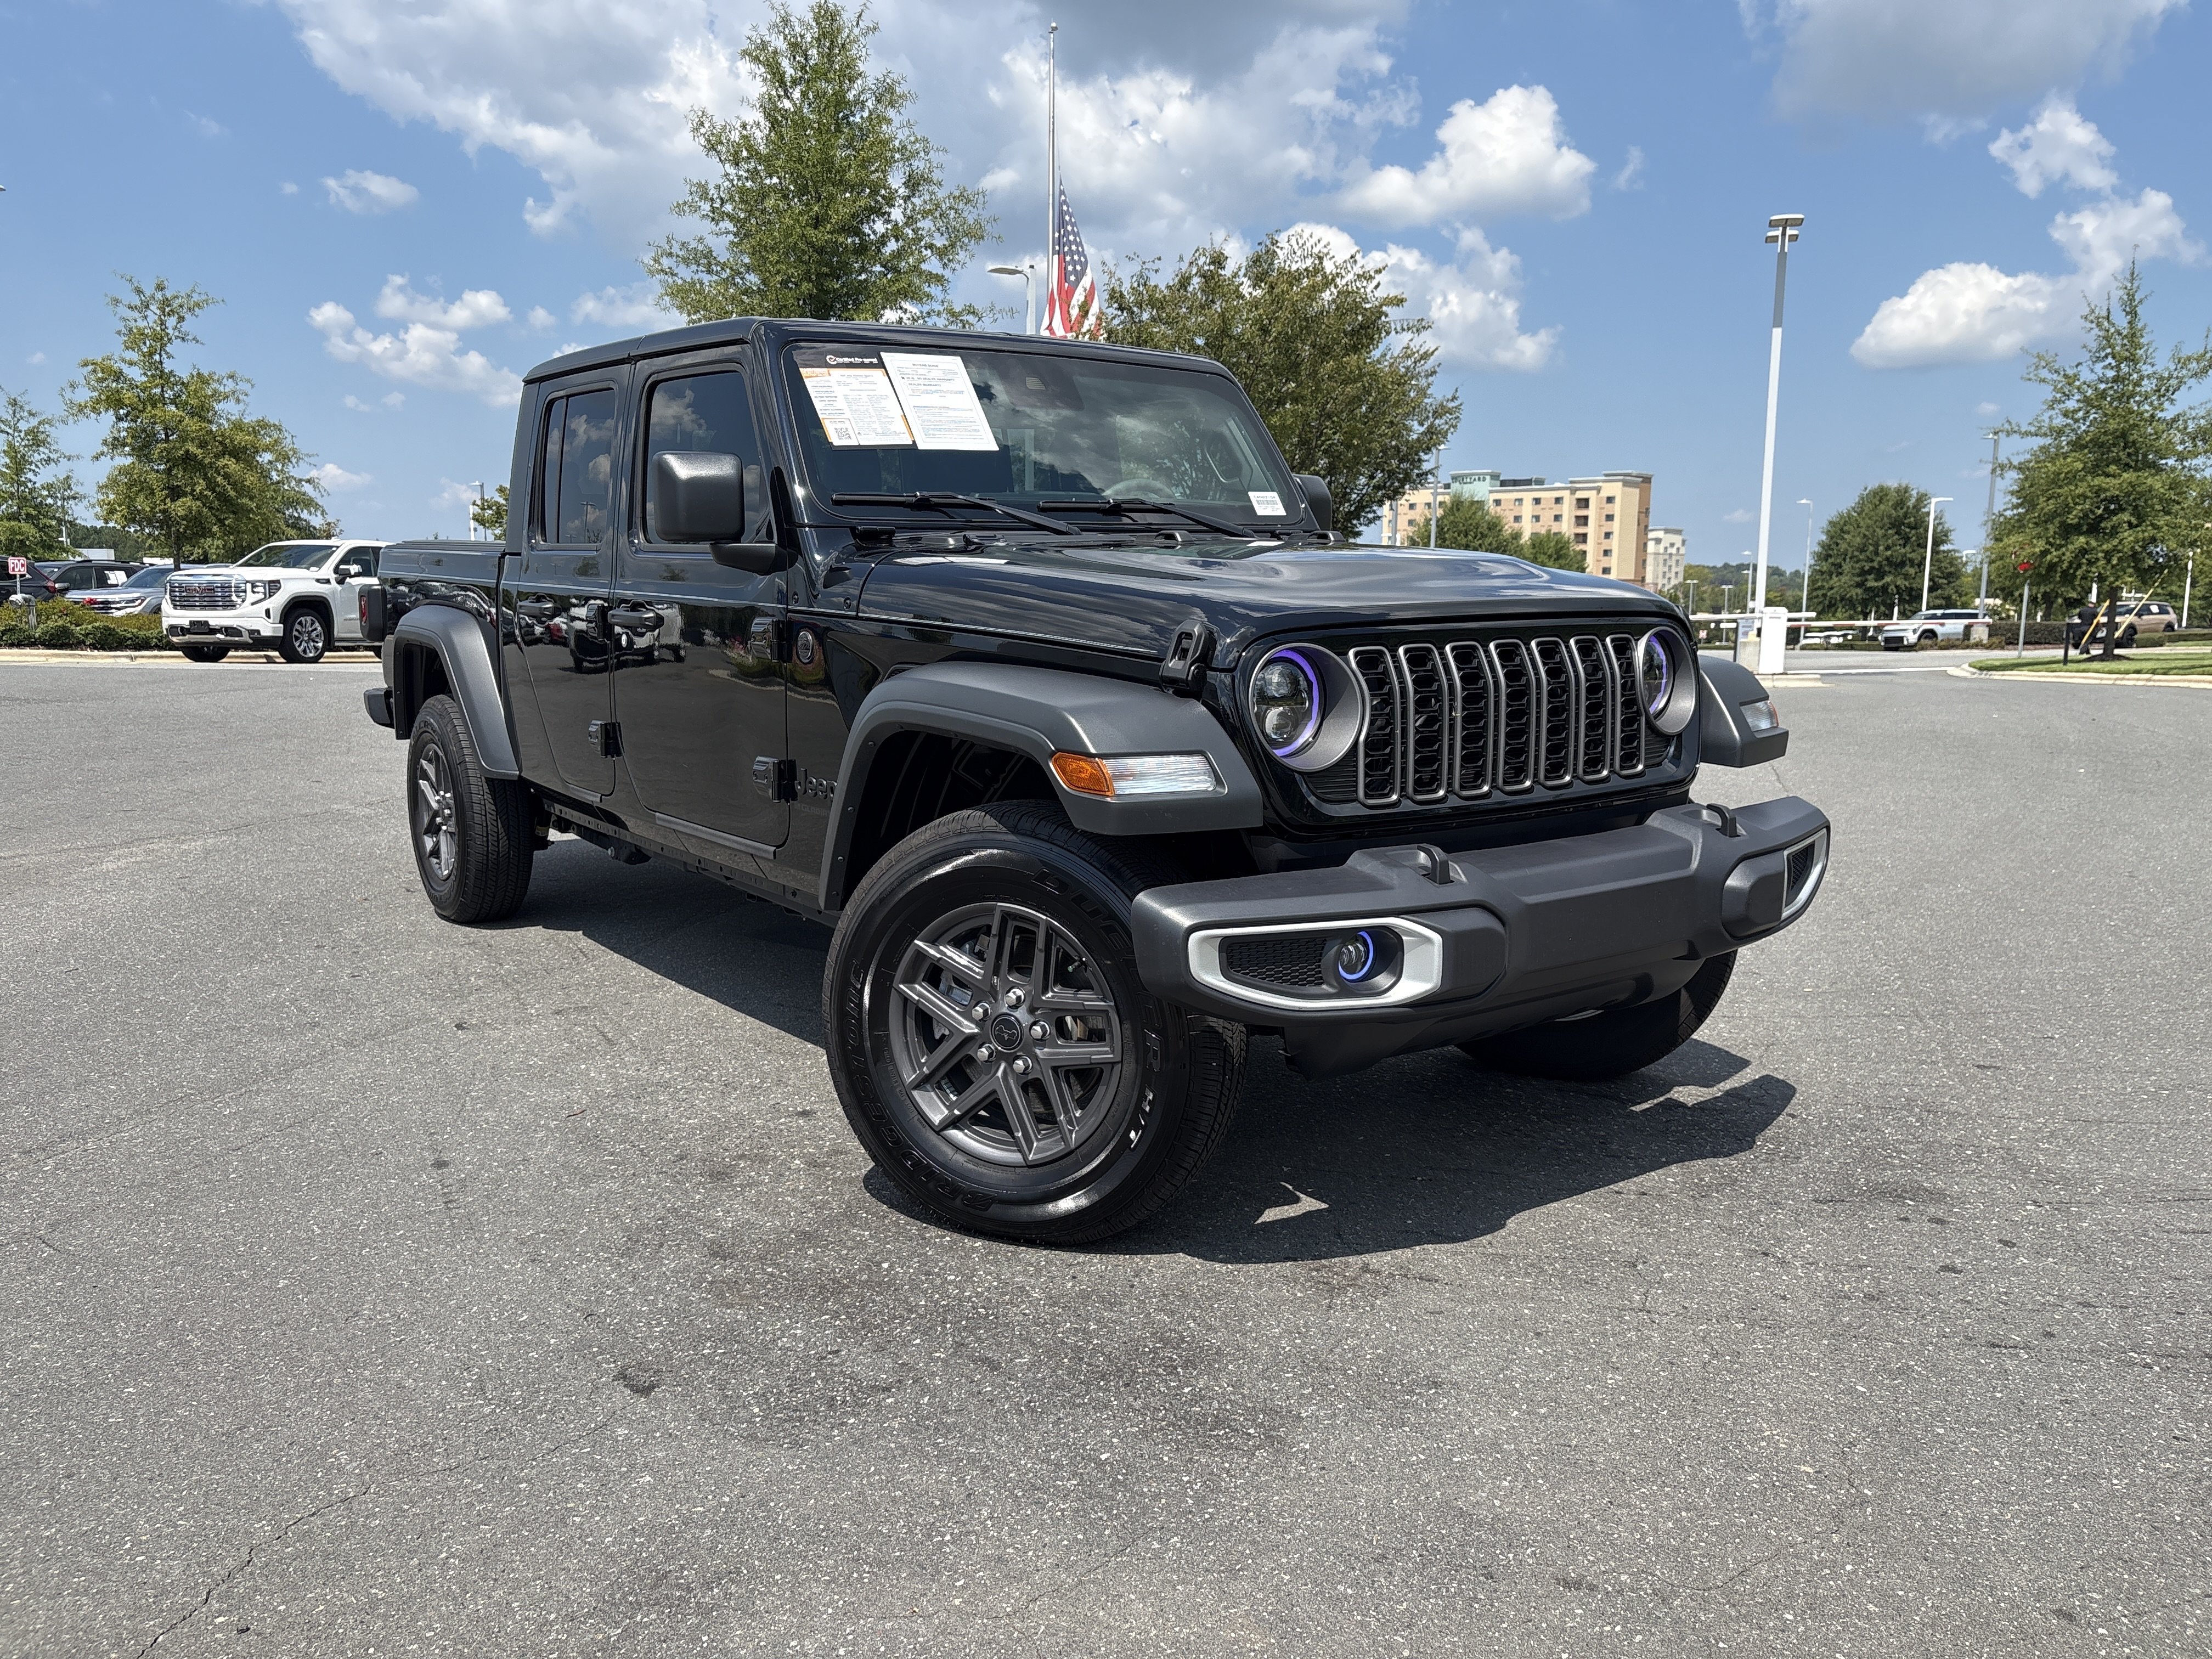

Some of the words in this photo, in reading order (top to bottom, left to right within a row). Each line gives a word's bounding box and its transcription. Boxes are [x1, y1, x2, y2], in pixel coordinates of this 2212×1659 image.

[10, 559, 25, 572] FDC
[795, 768, 837, 802] Jeep
[801, 804, 828, 816] GLADIA
[845, 960, 997, 1212] BRIDGESTONE
[1130, 1084, 1157, 1150] H/T
